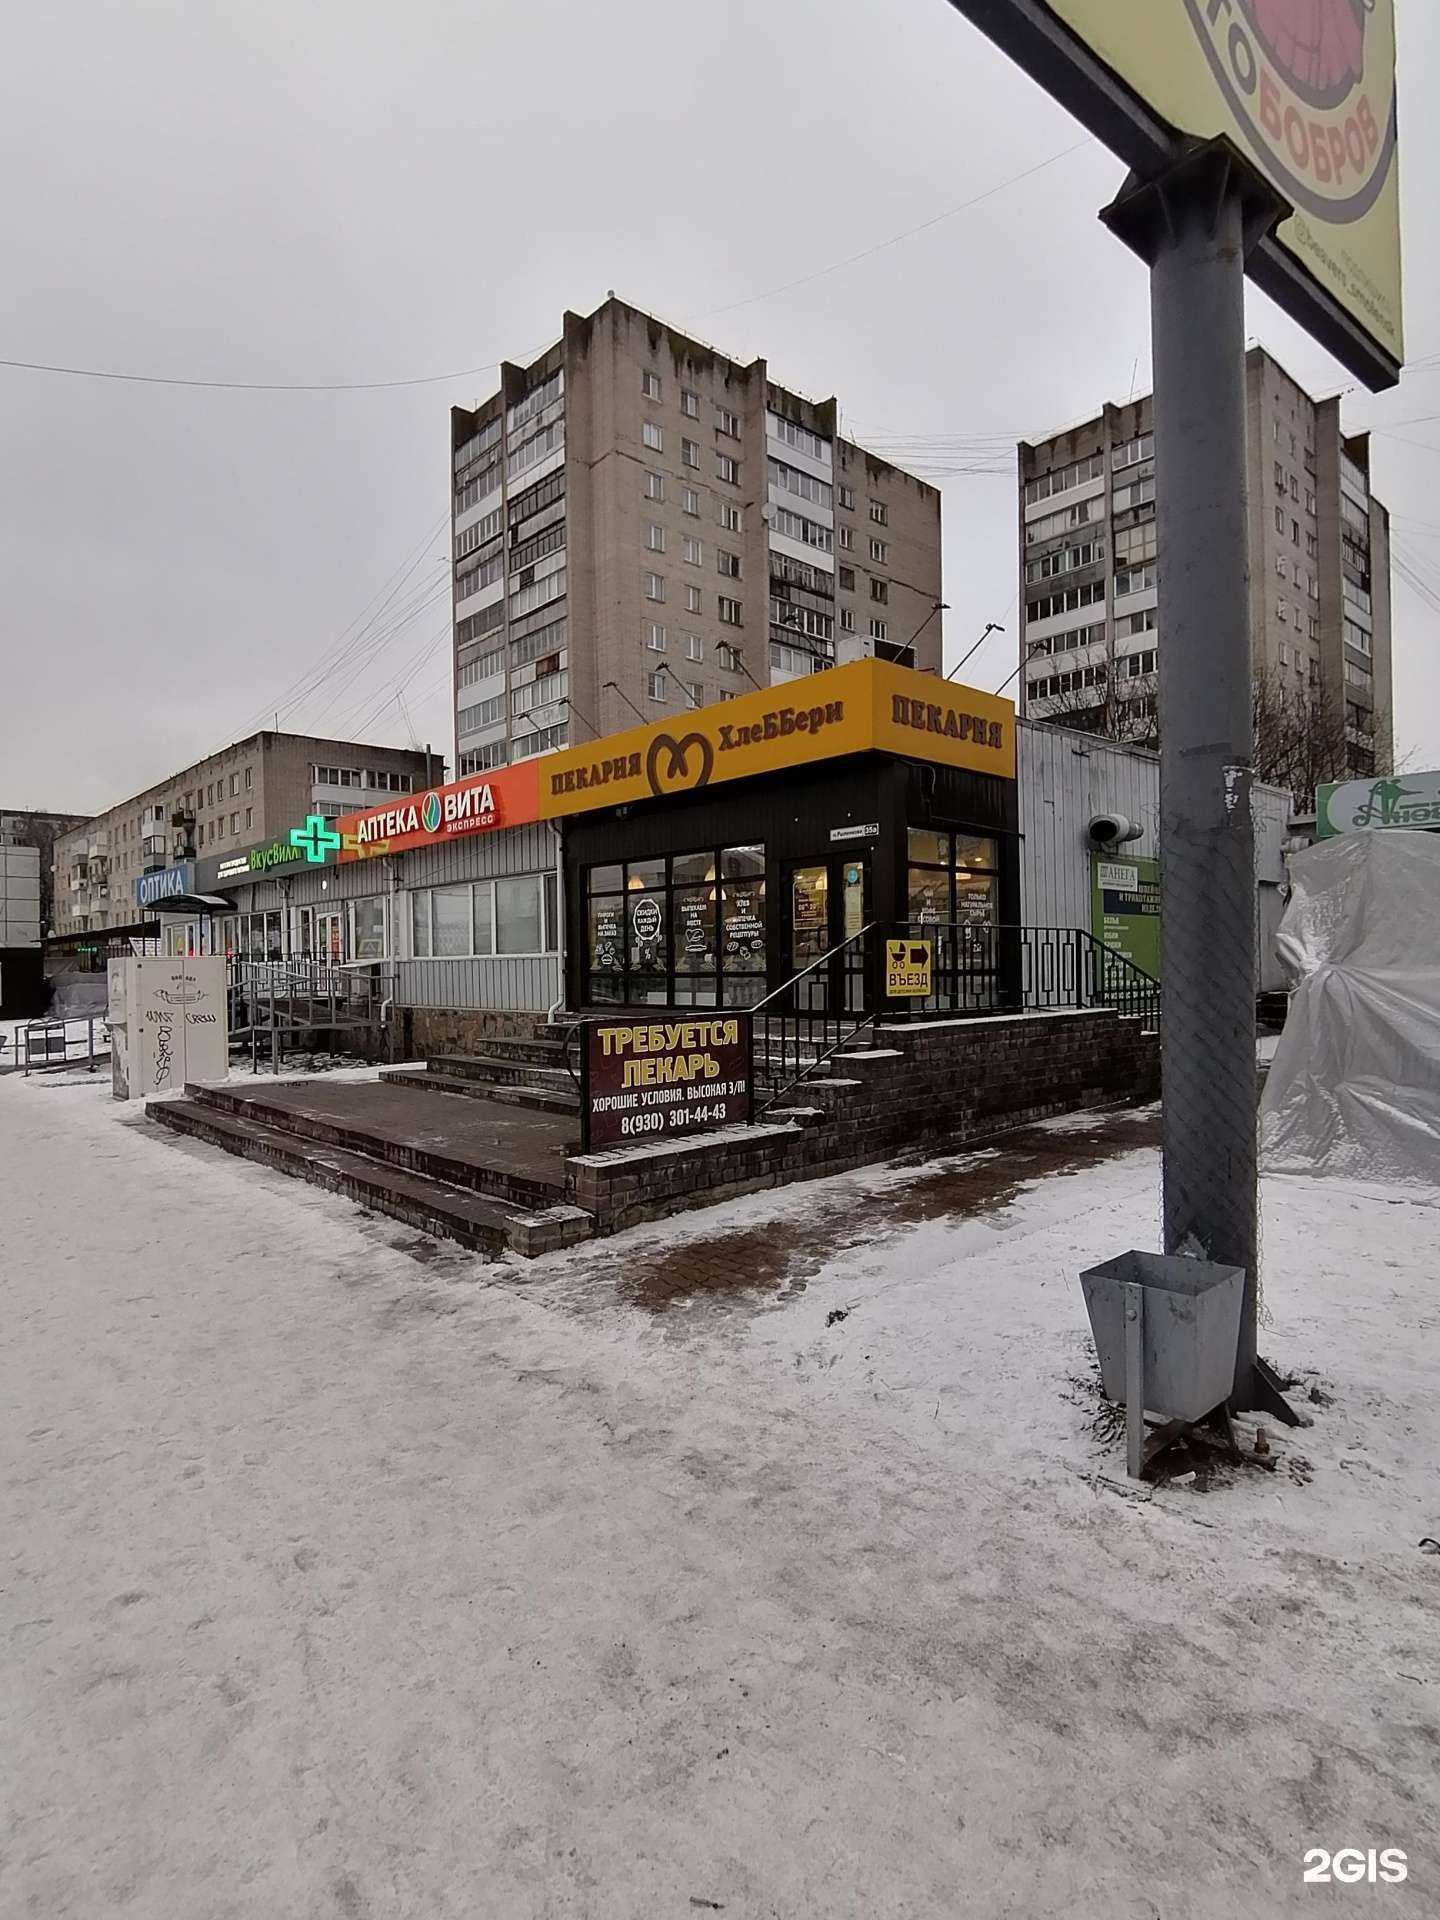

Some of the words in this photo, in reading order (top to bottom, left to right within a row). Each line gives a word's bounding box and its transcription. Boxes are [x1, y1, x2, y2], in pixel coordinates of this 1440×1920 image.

[1260, 64, 1379, 186] БОБРОВ
[892, 694, 1003, 749] ПЕКАРНЯ
[550, 752, 641, 795] ПЕКАРНЯ
[718, 701, 844, 751] ХлеББери
[358, 806, 419, 843] АПТЕКА
[444, 784, 495, 822] ВИТА
[447, 814, 494, 833] ЭКСПРЕСС
[139, 870, 184, 901] ОПТИКА
[636, 908, 658, 916] СКИДКИ
[637, 916, 657, 924] КАЖДЫЙ
[726, 920, 763, 931] СОБСТВЕННОЙ
[640, 925, 655, 933] ДЕНЬ
[889, 973, 929, 988] ВЪЕЗД
[597, 1020, 739, 1056] ТРЕБУЕТСЯ
[621, 1053, 720, 1089] ПЕКАРЬ
[592, 1094, 639, 1113] ХОРОШИЕ
[641, 1088, 685, 1106] УСЛОВИЯ.
[687, 1082, 727, 1100] ВЫСОКАЯ
[621, 1112, 665, 1135] 8(930)
[669, 1103, 727, 1127] 301-44-43
